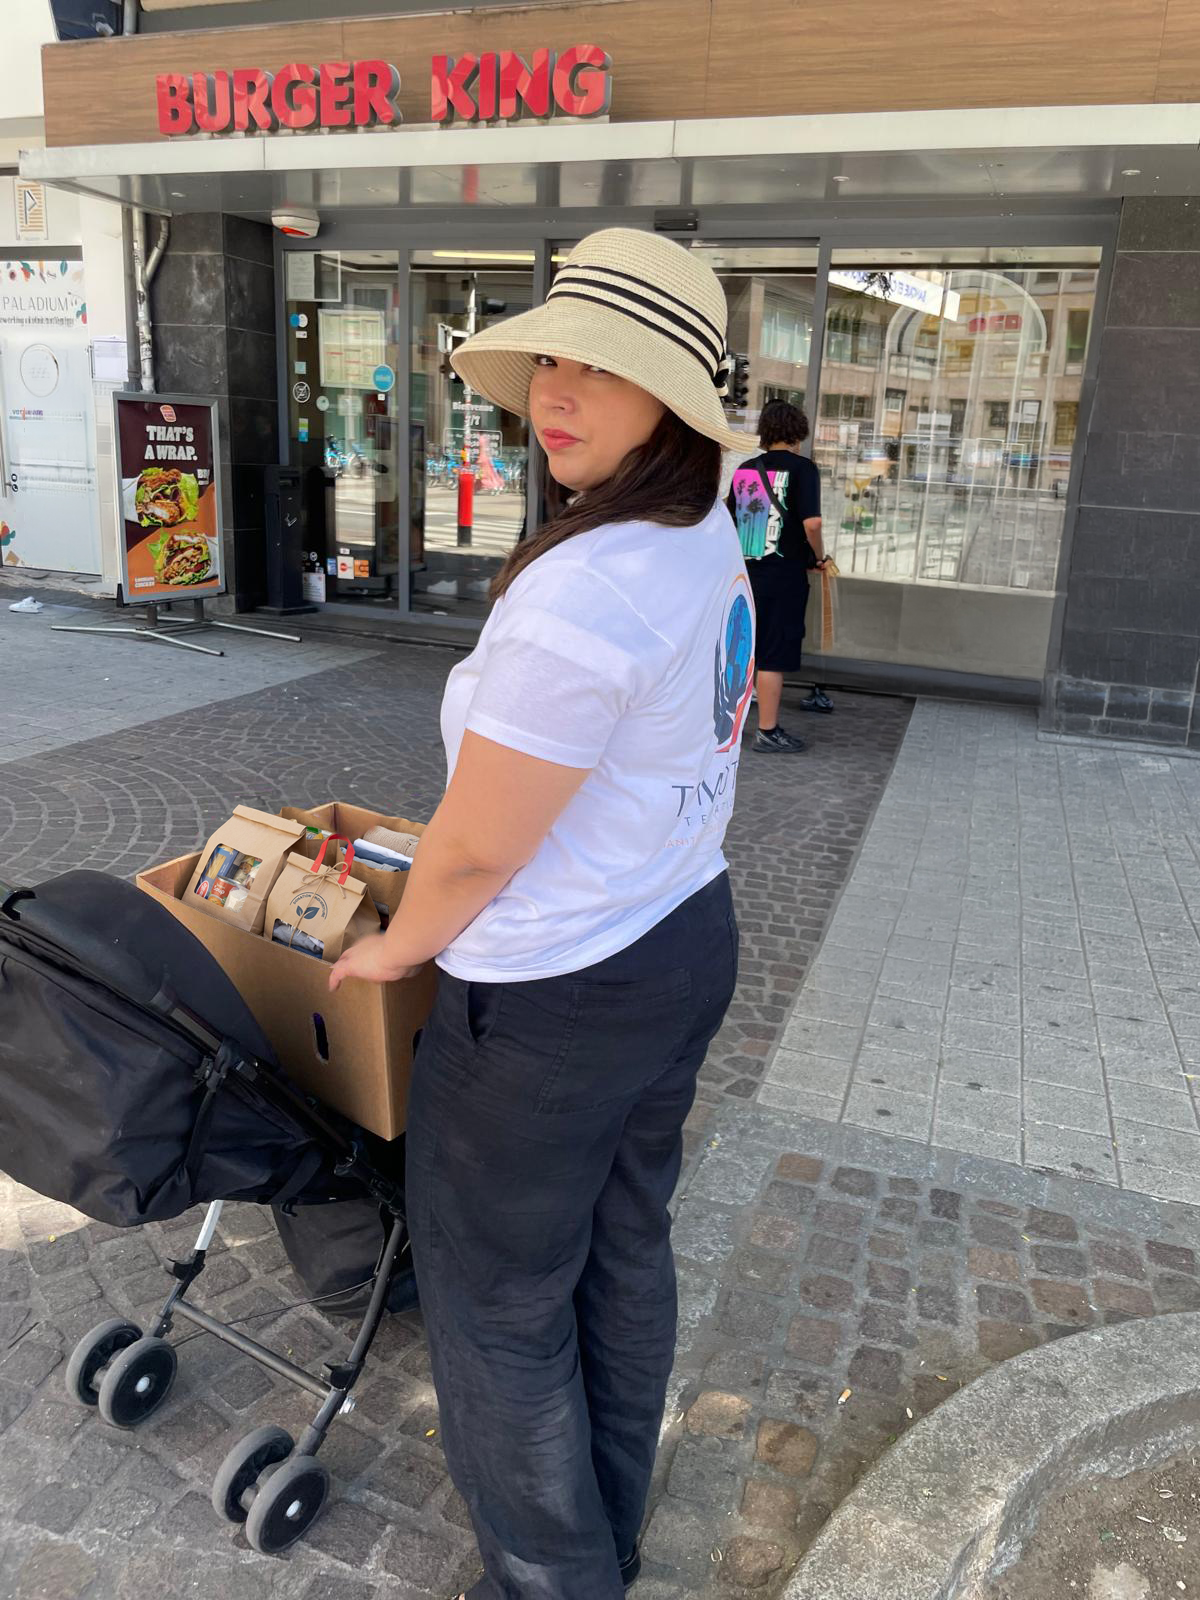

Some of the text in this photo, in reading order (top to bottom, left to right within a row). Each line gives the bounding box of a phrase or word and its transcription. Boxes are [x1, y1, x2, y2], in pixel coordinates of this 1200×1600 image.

[156, 44, 612, 135] BURGER KING
[3, 296, 69, 311] PALADIUM
[146, 425, 194, 442] THAT'S
[144, 445, 198, 461] A WRAP.
